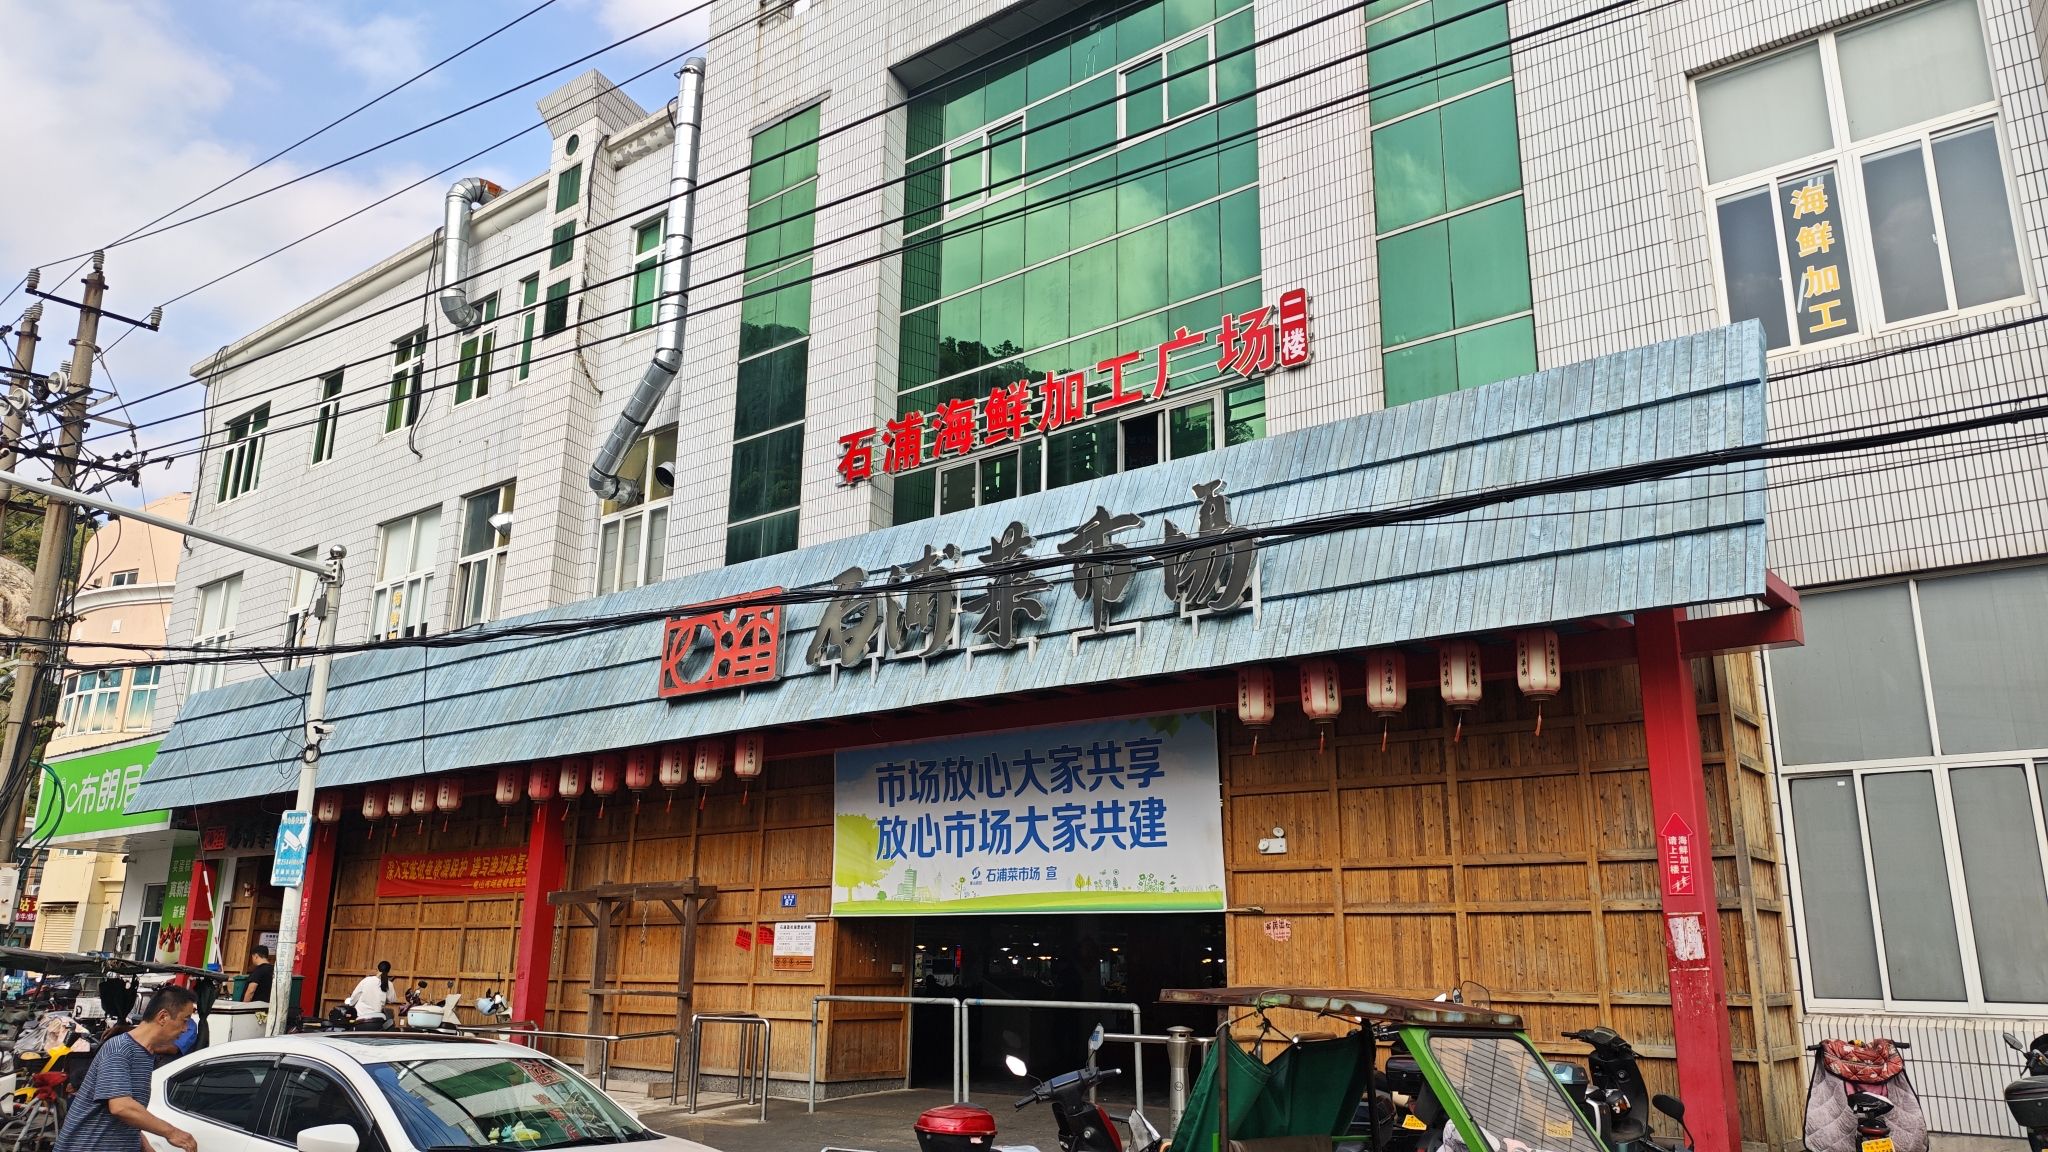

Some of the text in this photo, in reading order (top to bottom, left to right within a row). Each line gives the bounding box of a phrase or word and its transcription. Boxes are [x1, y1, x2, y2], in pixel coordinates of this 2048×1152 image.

[1790, 183, 1847, 334] 海鲜加工
[1281, 294, 1306, 362] 二楼
[836, 304, 1278, 486] 石浦海鲜加工广场
[805, 479, 1259, 670] 石浦菜市场
[65, 763, 150, 814] 布朗尼
[875, 736, 1165, 808] 市场放心大家共享
[876, 796, 1168, 861] 放心市场大家共建
[1668, 836, 1680, 875] 请上二楼
[1678, 836, 1690, 874] 海鲜加工
[470, 853, 529, 878] 谱写渔场修复
[985, 865, 1058, 882] 石浦菜市场 宣
